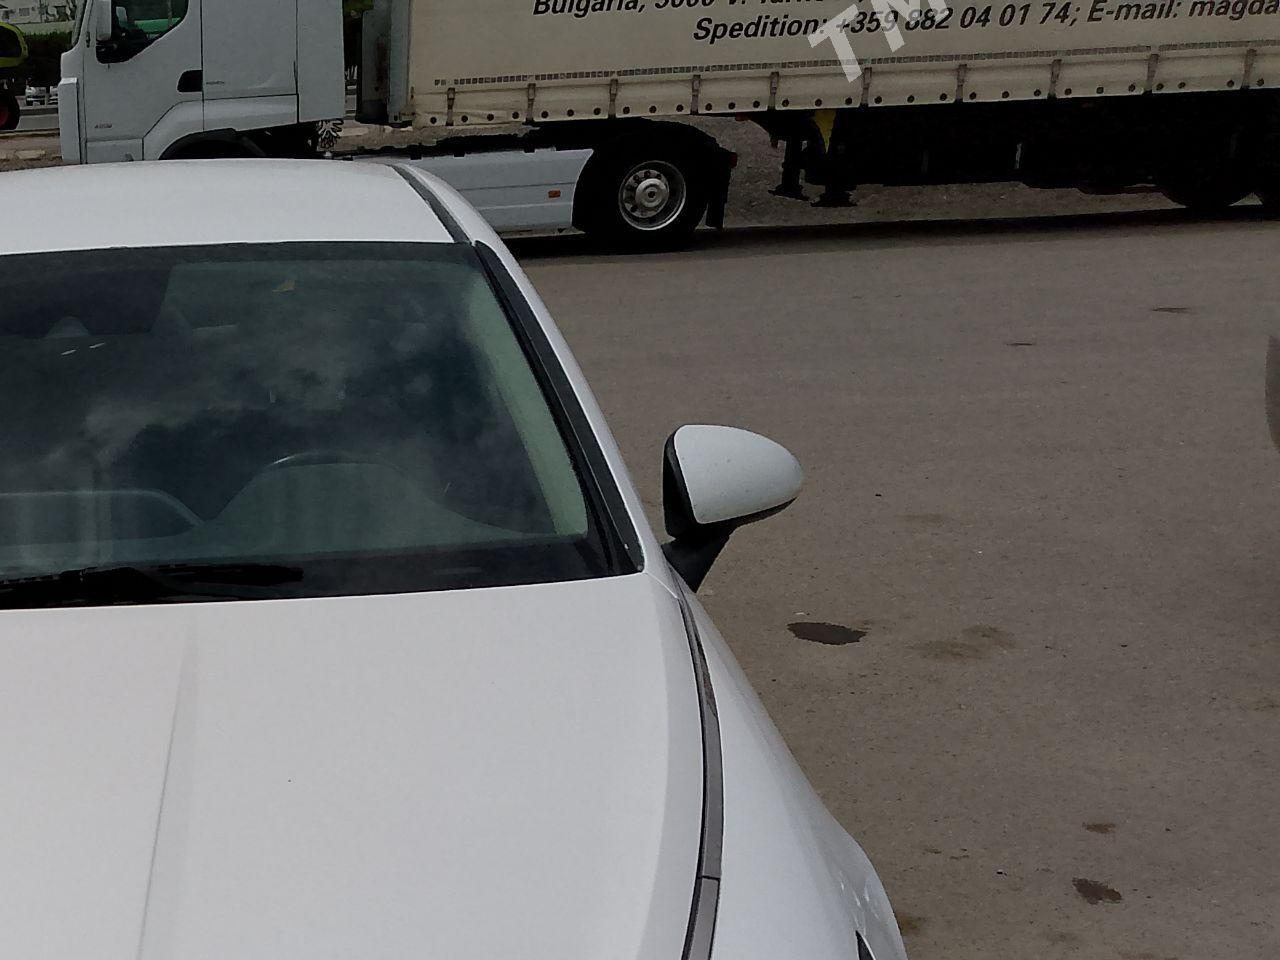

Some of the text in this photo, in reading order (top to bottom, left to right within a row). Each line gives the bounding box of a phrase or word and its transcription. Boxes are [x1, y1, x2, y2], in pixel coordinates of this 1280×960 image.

[693, 14, 828, 45] Spedition:
[960, 5, 992, 29] 04
[998, 2, 1031, 27] 01
[1039, 1, 1081, 26] 74;
[1086, 0, 1180, 22] E-mail:
